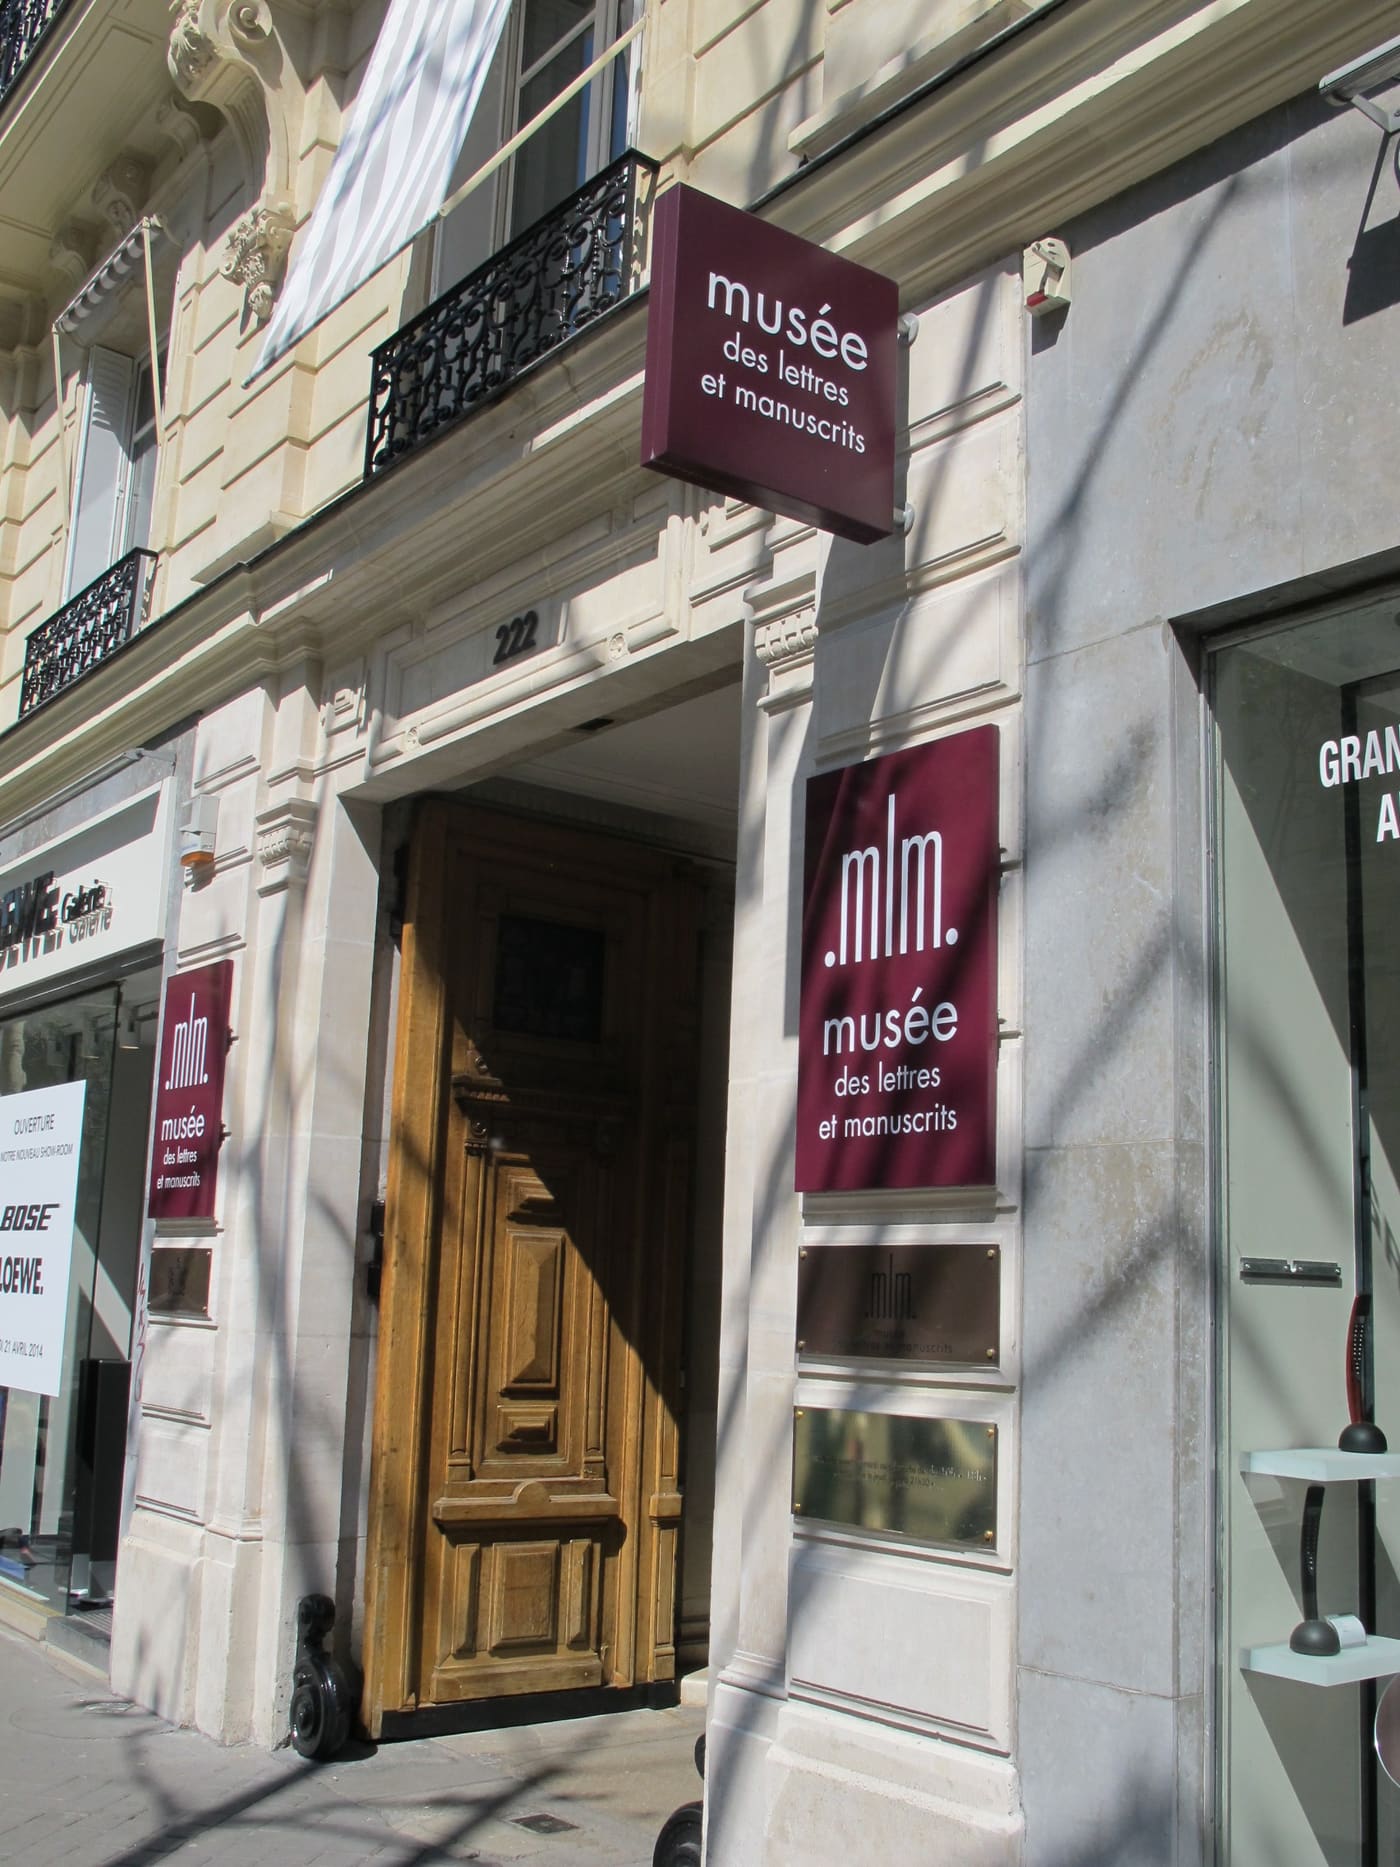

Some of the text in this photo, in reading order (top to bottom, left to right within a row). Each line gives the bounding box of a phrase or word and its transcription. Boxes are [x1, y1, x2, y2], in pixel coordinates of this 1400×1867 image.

[708, 271, 868, 371] musée
[723, 332, 849, 406] des lettres
[701, 373, 865, 454] et manuscrits
[493, 610, 538, 665] 222
[823, 986, 957, 1055] musée
[834, 1060, 941, 1097] des lettres
[14, 1113, 55, 1135] OUVERTURE
[161, 1105, 205, 1141] musée
[818, 1103, 957, 1140] et manuscrits
[163, 1145, 197, 1165] des lettres
[157, 1173, 201, 1189] et manuscrits
[0, 1203, 60, 1231] BOSE
